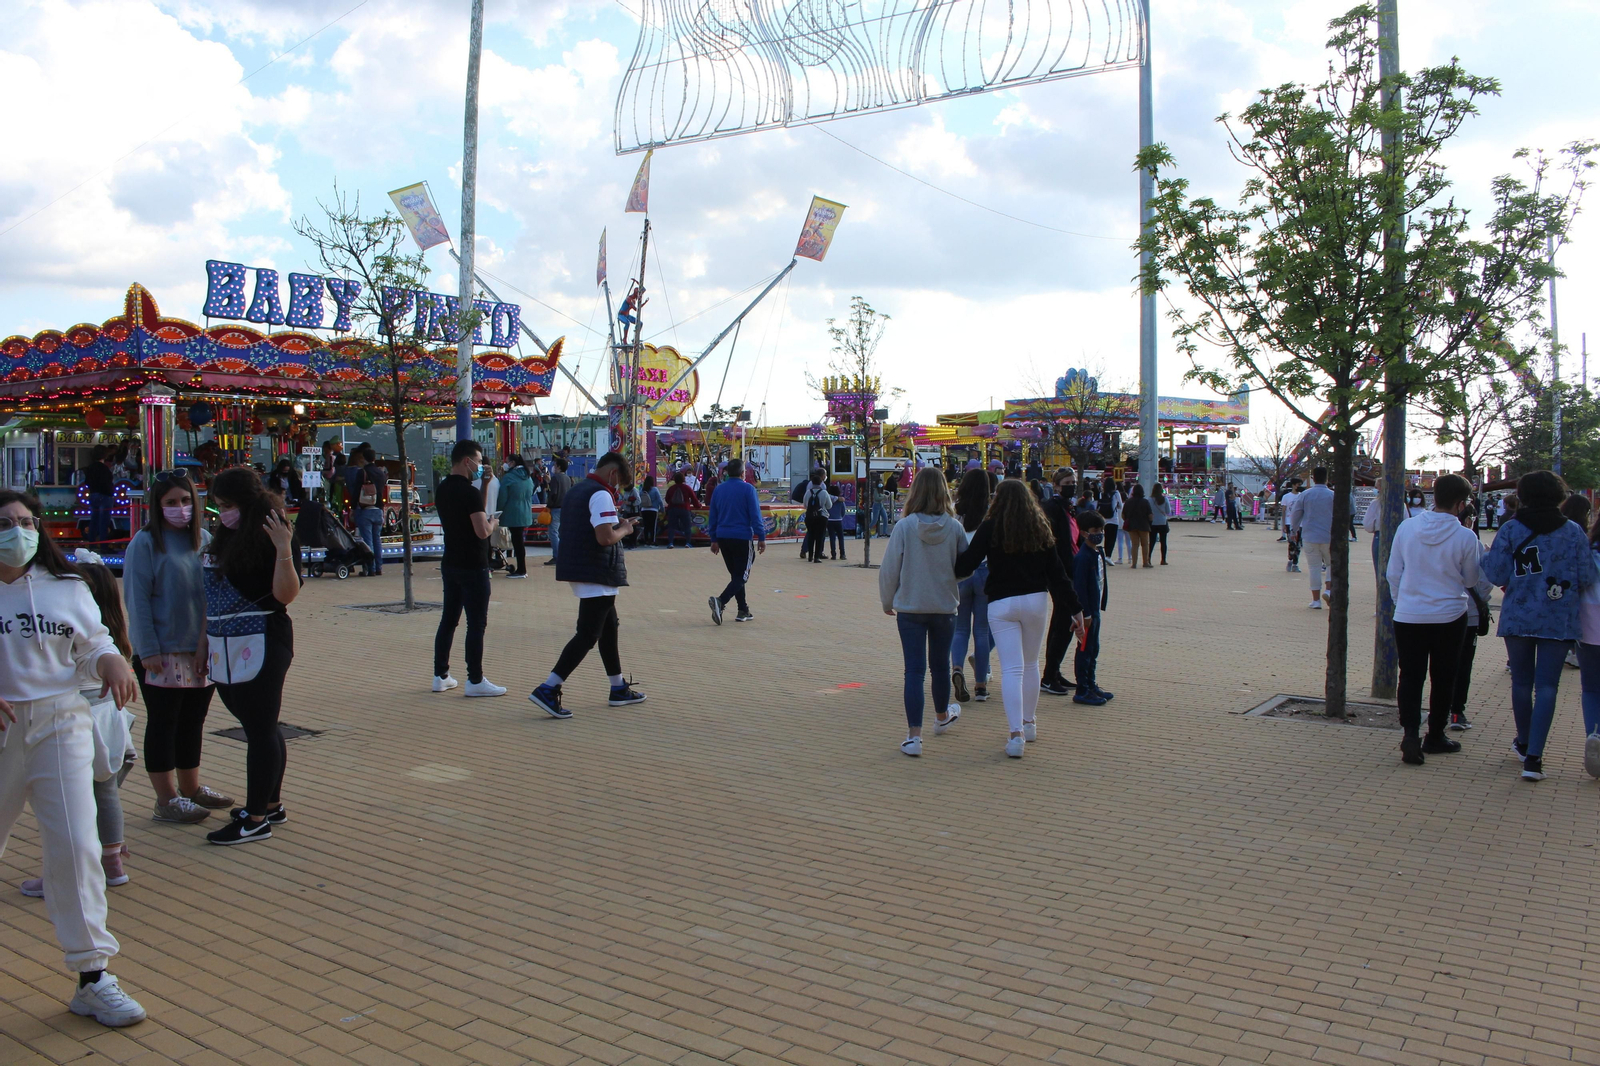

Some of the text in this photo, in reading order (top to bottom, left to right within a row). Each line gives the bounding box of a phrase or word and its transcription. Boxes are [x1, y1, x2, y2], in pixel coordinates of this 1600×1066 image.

[203, 259, 522, 348] BABY PINTO
[56, 431, 95, 443] BABY
[1513, 546, 1543, 577] M
[16, 613, 74, 638] Muse
